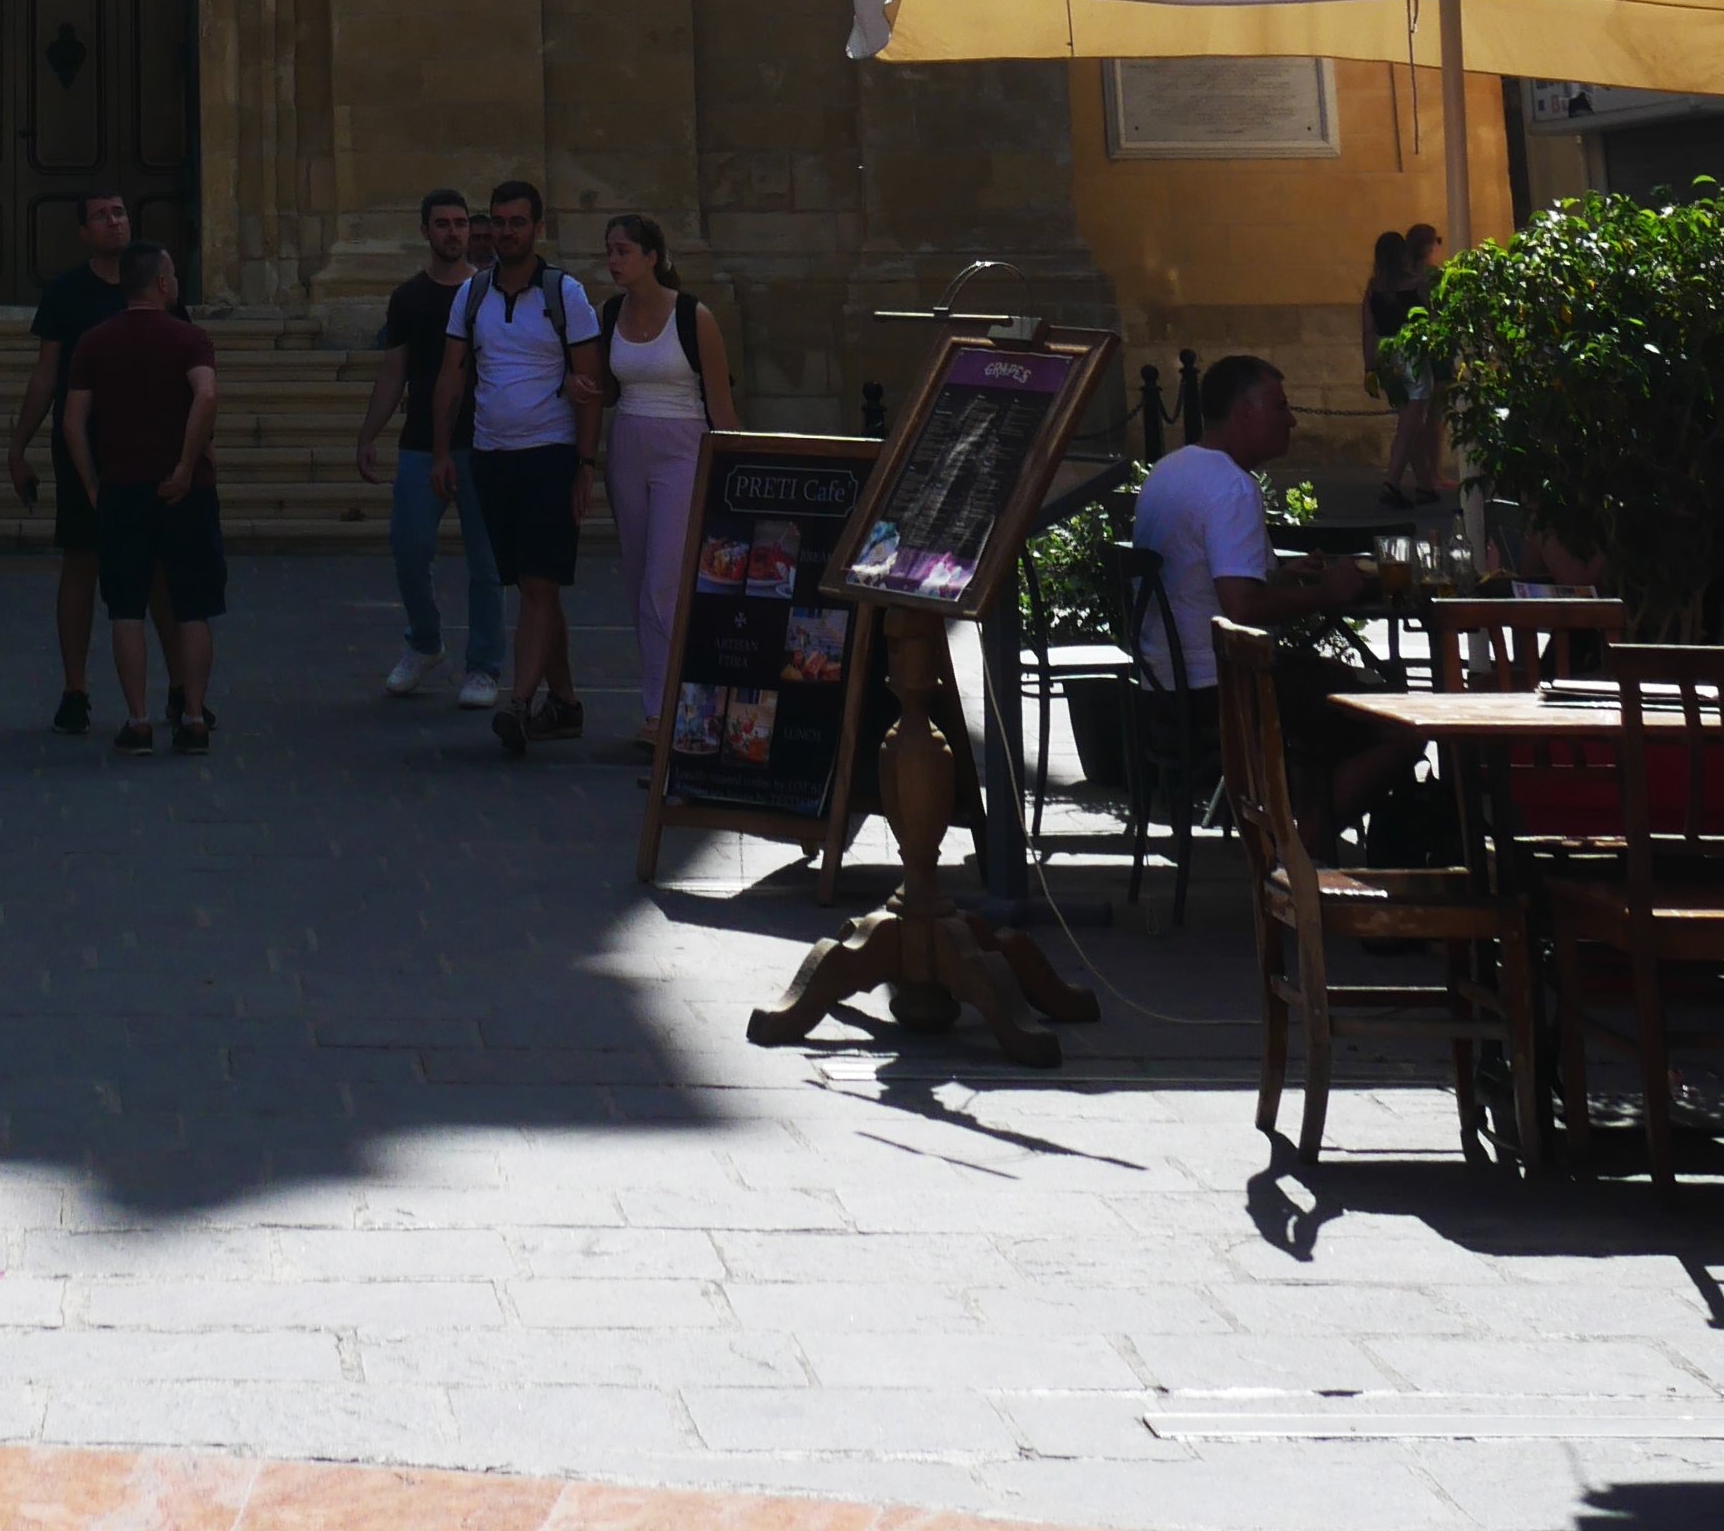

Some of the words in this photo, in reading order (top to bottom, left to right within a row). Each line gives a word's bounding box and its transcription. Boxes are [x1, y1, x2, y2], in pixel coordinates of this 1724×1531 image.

[734, 474, 798, 500] PRETI
[714, 637, 759, 652] ARTISAN
[783, 726, 822, 743] LUNCH
